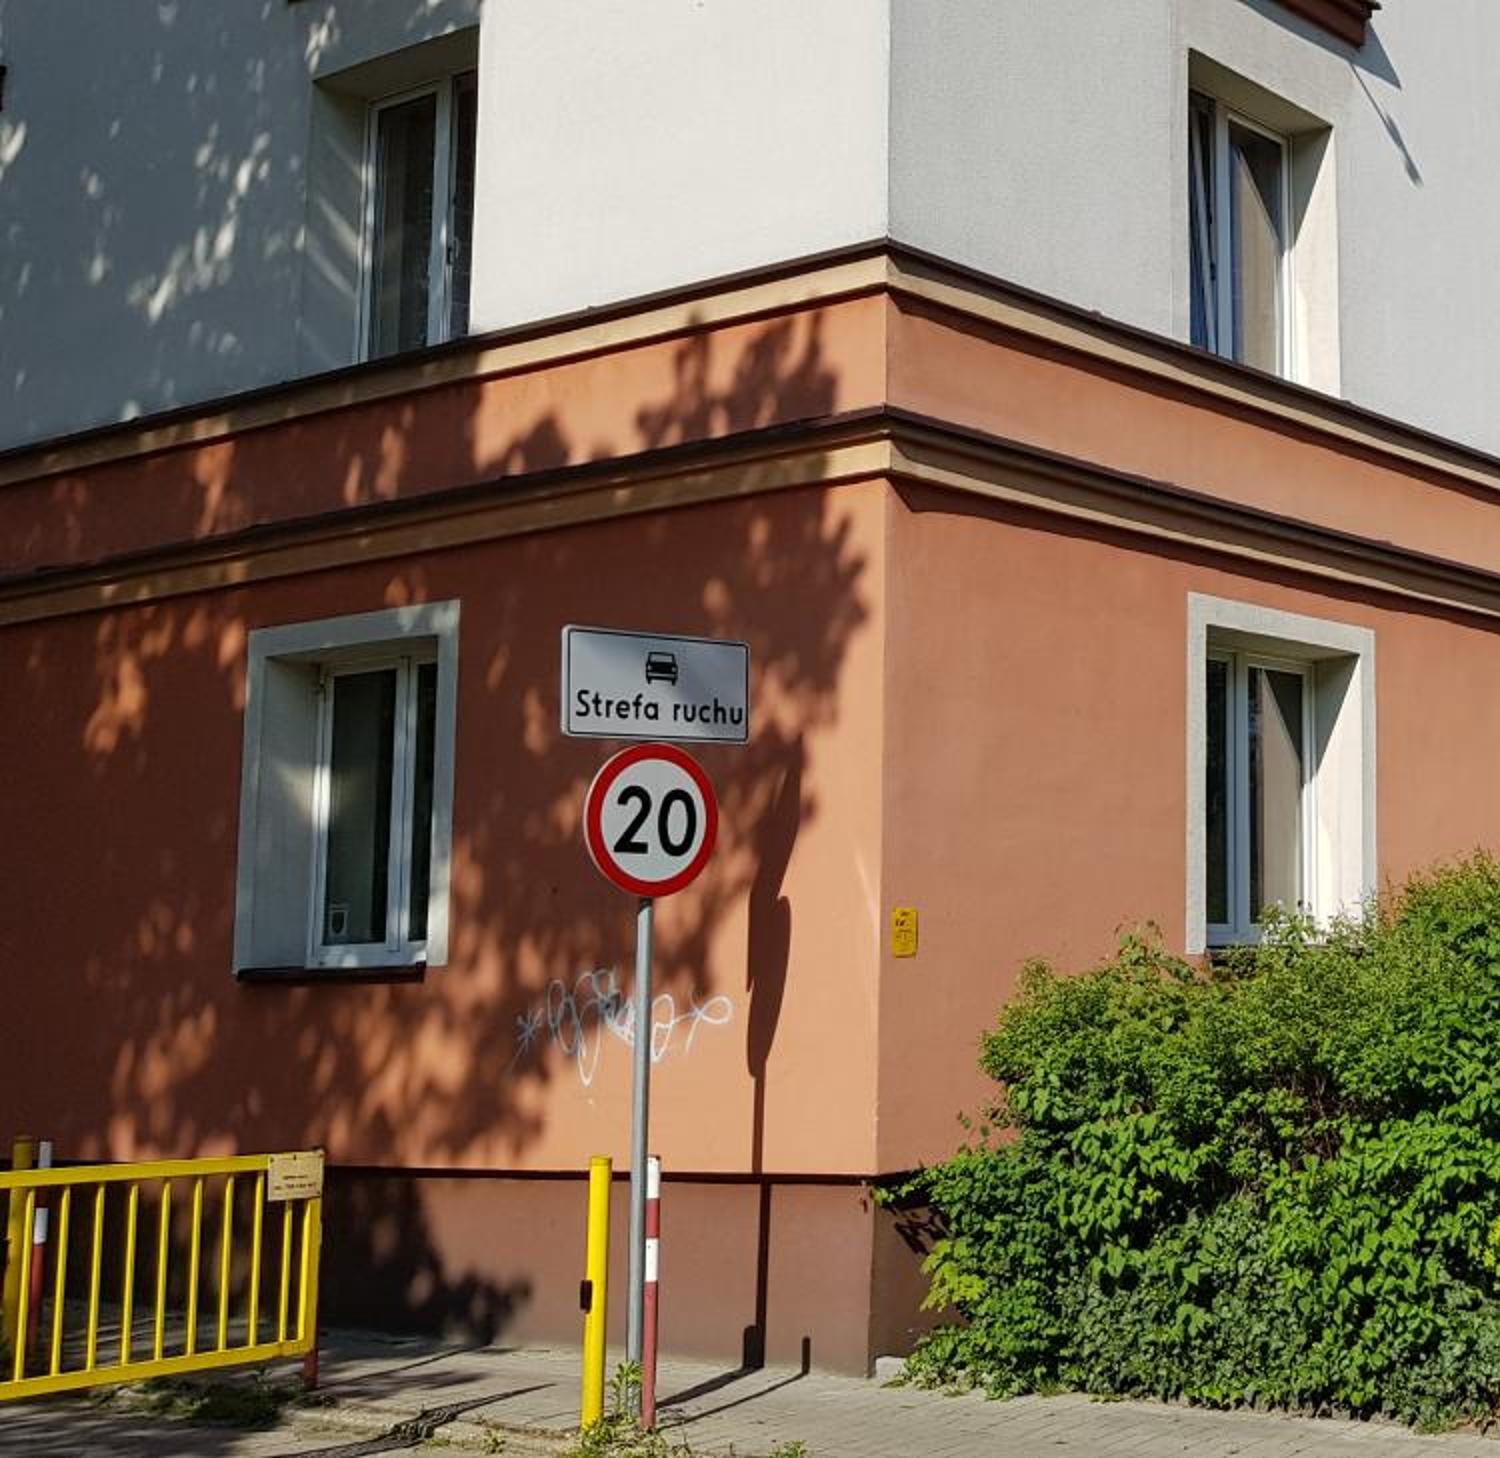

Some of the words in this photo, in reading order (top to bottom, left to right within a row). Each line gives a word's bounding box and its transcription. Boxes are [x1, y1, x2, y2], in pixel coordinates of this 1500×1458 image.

[575, 689, 659, 721] Strefa
[672, 698, 743, 726] ruchu
[613, 785, 698, 858] 20
